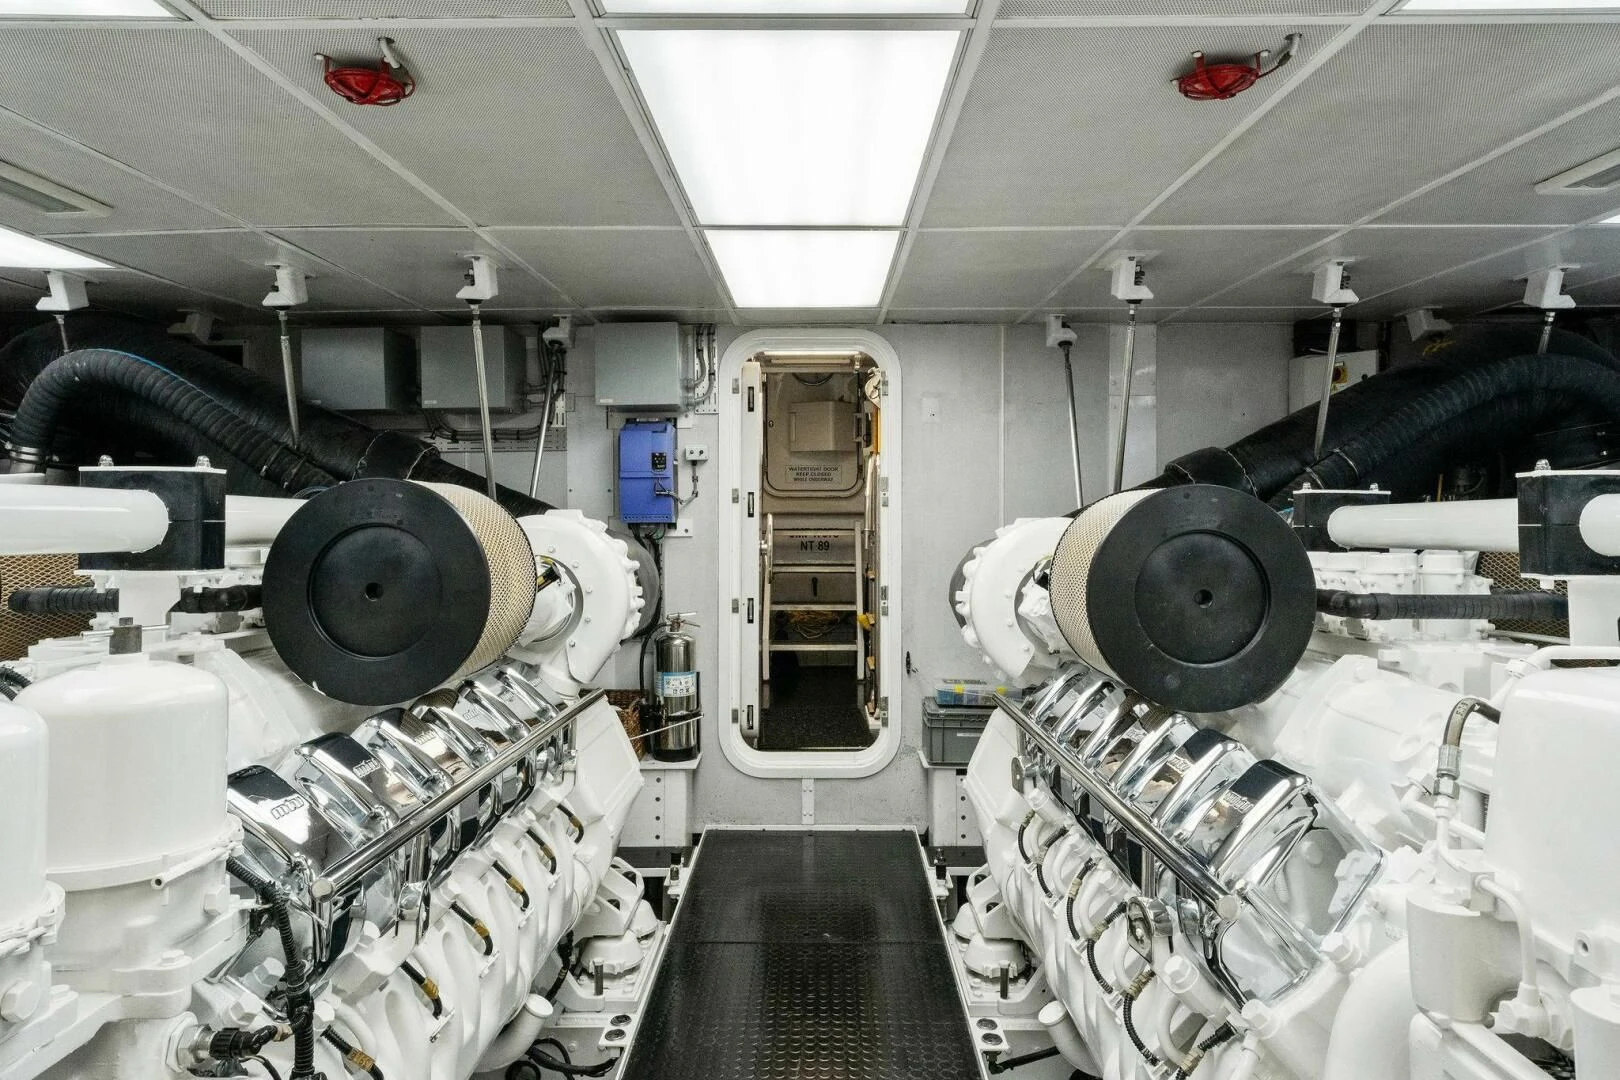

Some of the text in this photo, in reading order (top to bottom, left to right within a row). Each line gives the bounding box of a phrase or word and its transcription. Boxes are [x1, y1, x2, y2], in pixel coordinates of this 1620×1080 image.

[800, 540, 830, 551] NT 89
[352, 758, 381, 778] mtu
[270, 795, 305, 820] mtu
